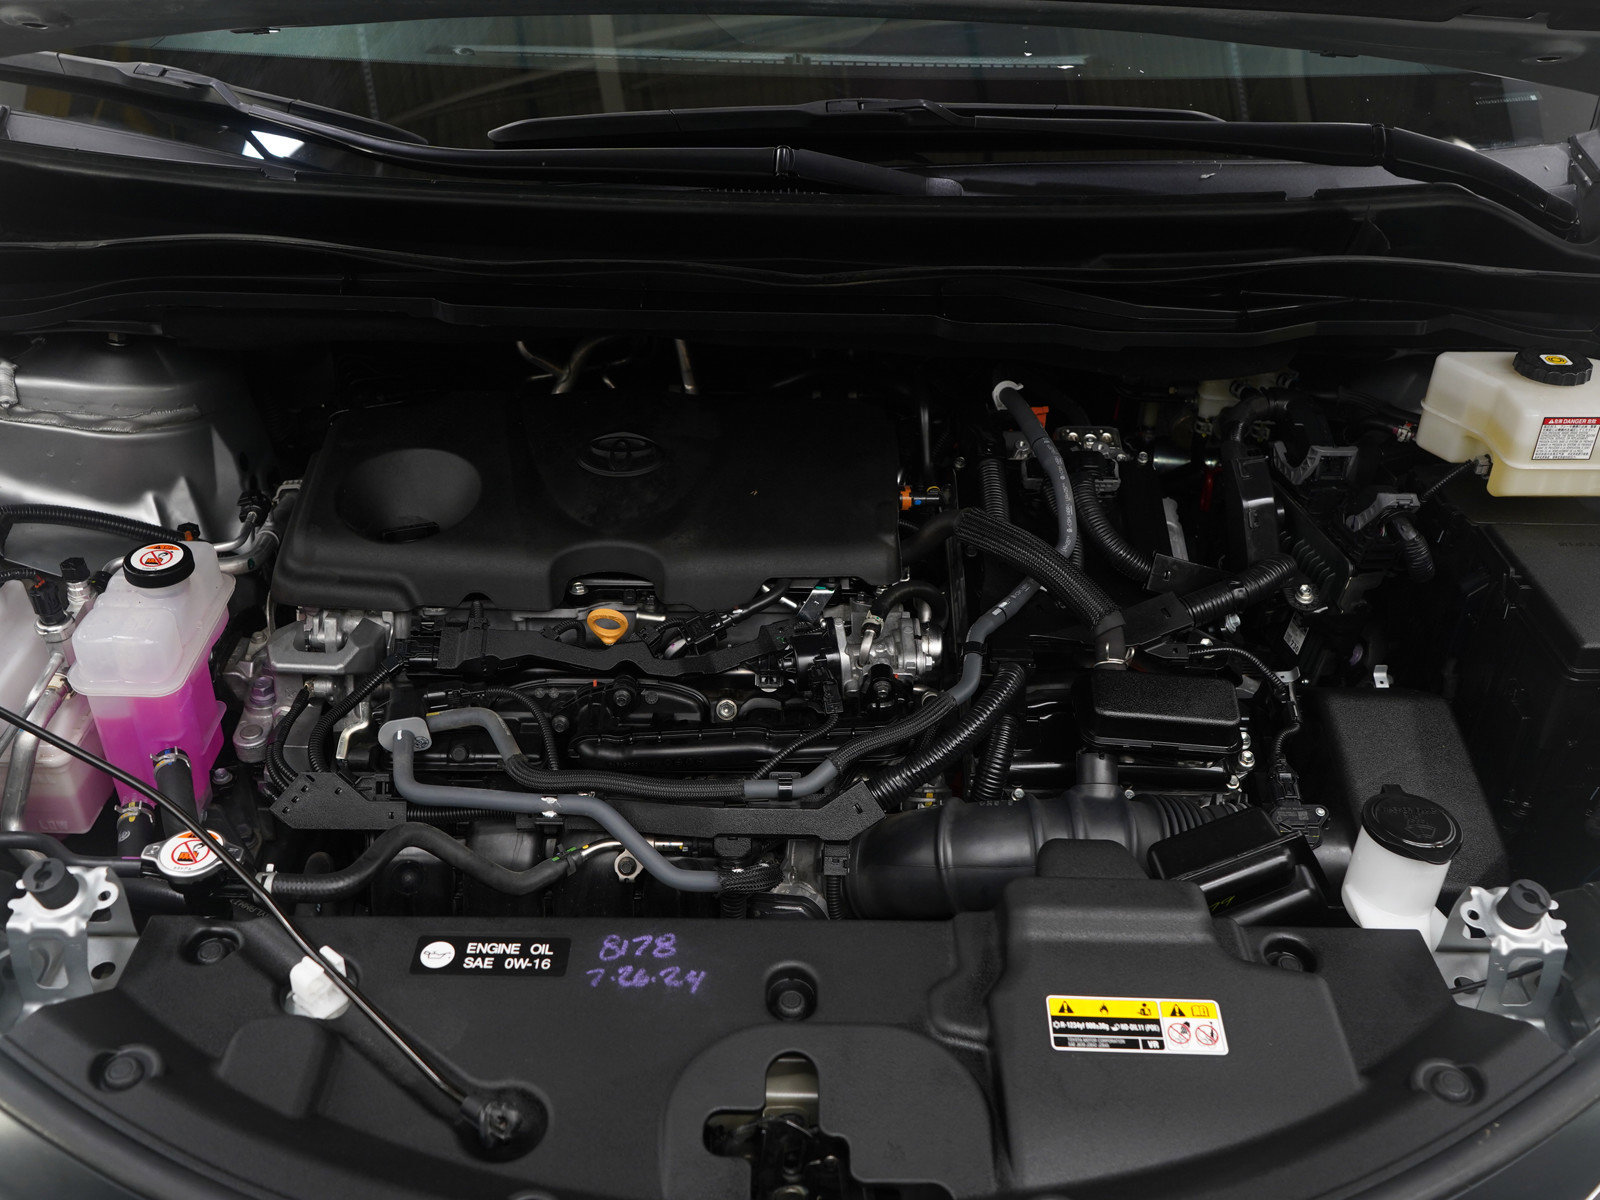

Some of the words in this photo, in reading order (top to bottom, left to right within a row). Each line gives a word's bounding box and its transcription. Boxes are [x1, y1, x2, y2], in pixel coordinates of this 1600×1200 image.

[466, 943, 520, 955] ENGINE
[530, 943, 554, 955] OIL
[599, 933, 677, 961] 8178
[463, 957, 494, 969] SAE
[504, 957, 551, 970] 0W-16
